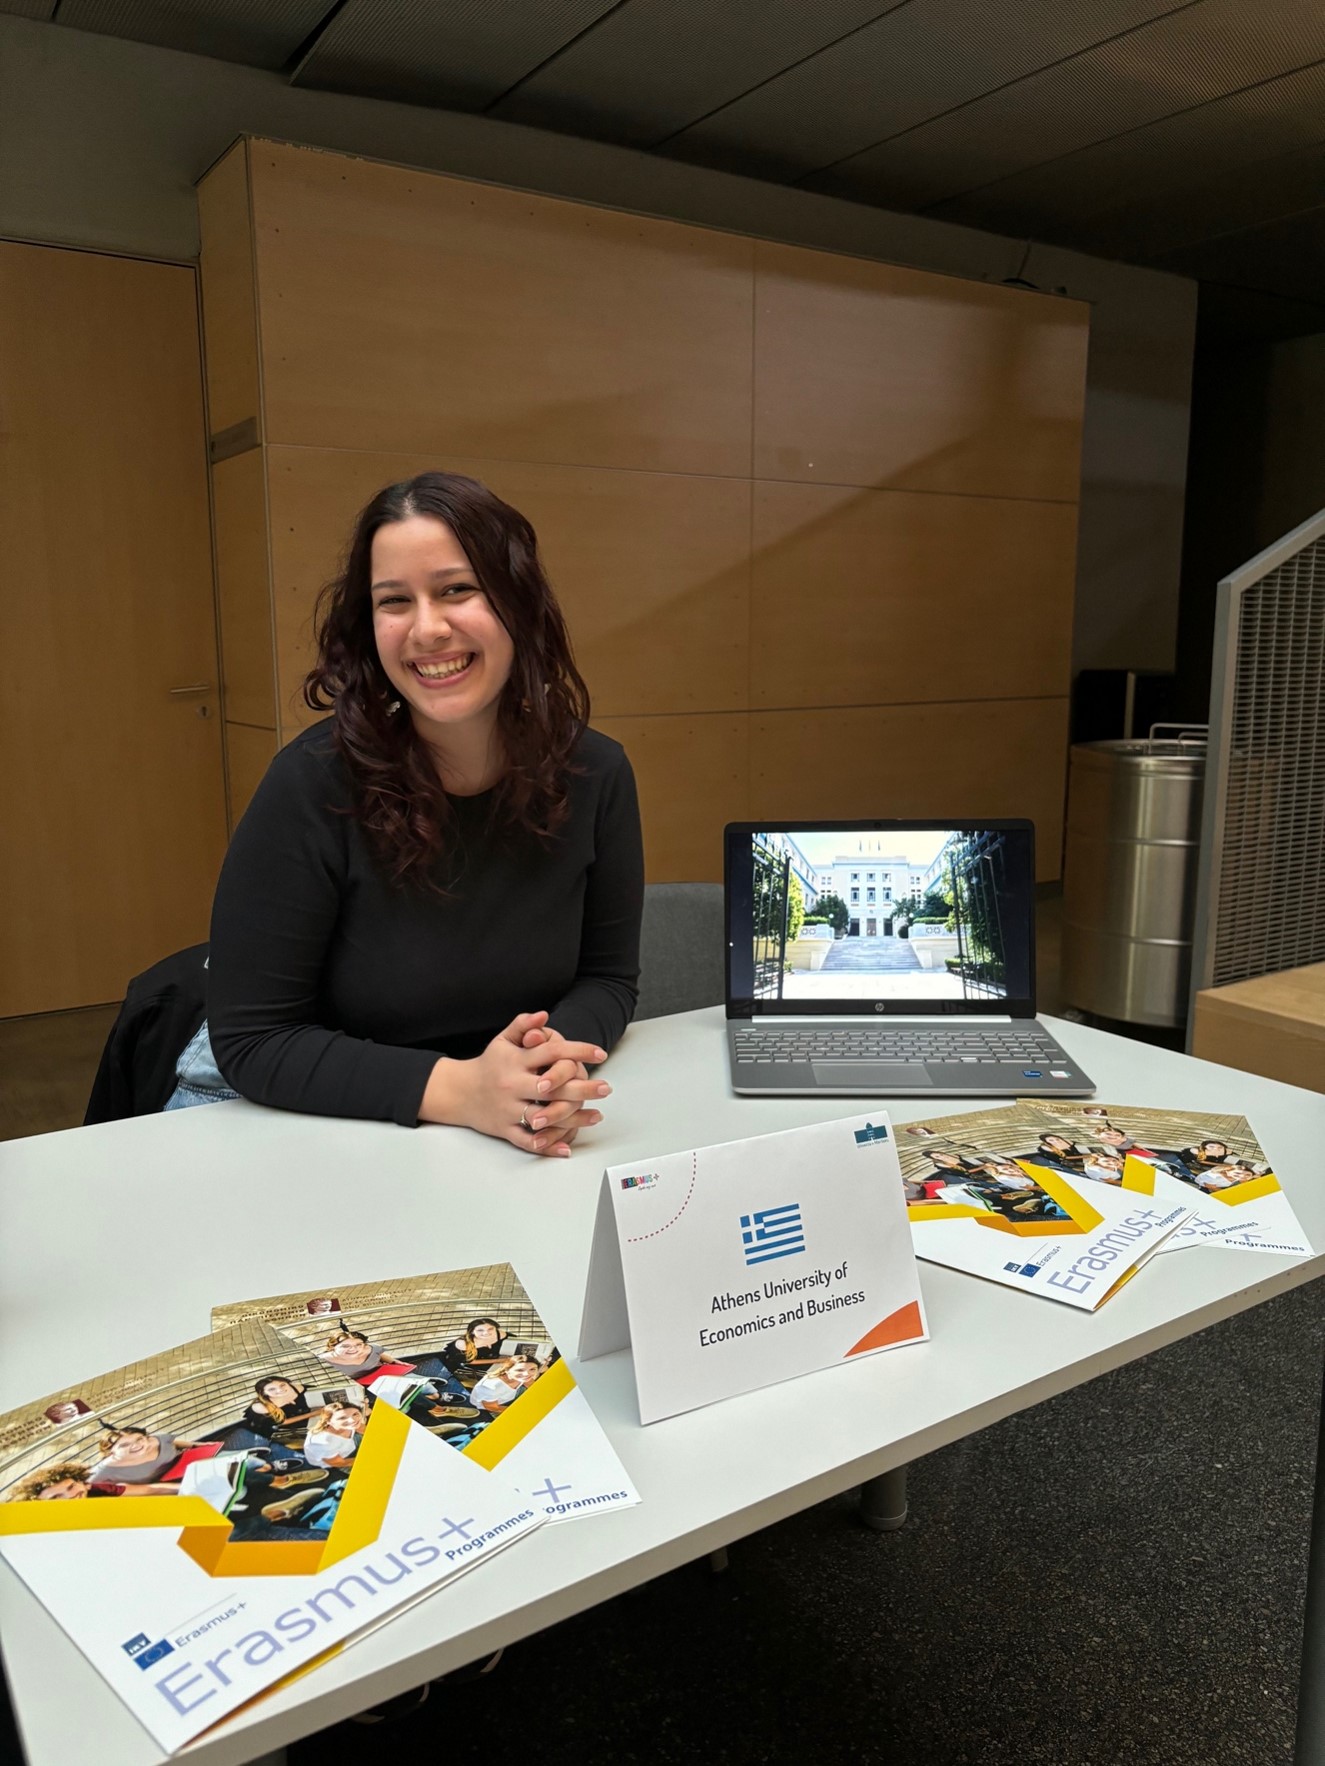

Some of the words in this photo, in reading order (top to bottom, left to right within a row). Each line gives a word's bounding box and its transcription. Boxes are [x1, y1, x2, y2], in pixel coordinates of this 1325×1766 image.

[1155, 1206, 1187, 1227] Programmes
[1200, 1221, 1259, 1237] Programmes
[1047, 1208, 1160, 1294] Erasmus+
[1225, 1238, 1305, 1252] Programmes
[711, 1288, 761, 1314] Athens
[764, 1268, 832, 1299] University
[834, 1261, 848, 1280] of
[699, 1315, 775, 1347] Economics
[779, 1303, 804, 1324] and
[807, 1291, 866, 1317] Business
[543, 1490, 628, 1514] ogrammes
[444, 1508, 535, 1561] Programmes
[155, 1515, 475, 1716] Erasmus+
[175, 1601, 247, 1647] Erasmus+
